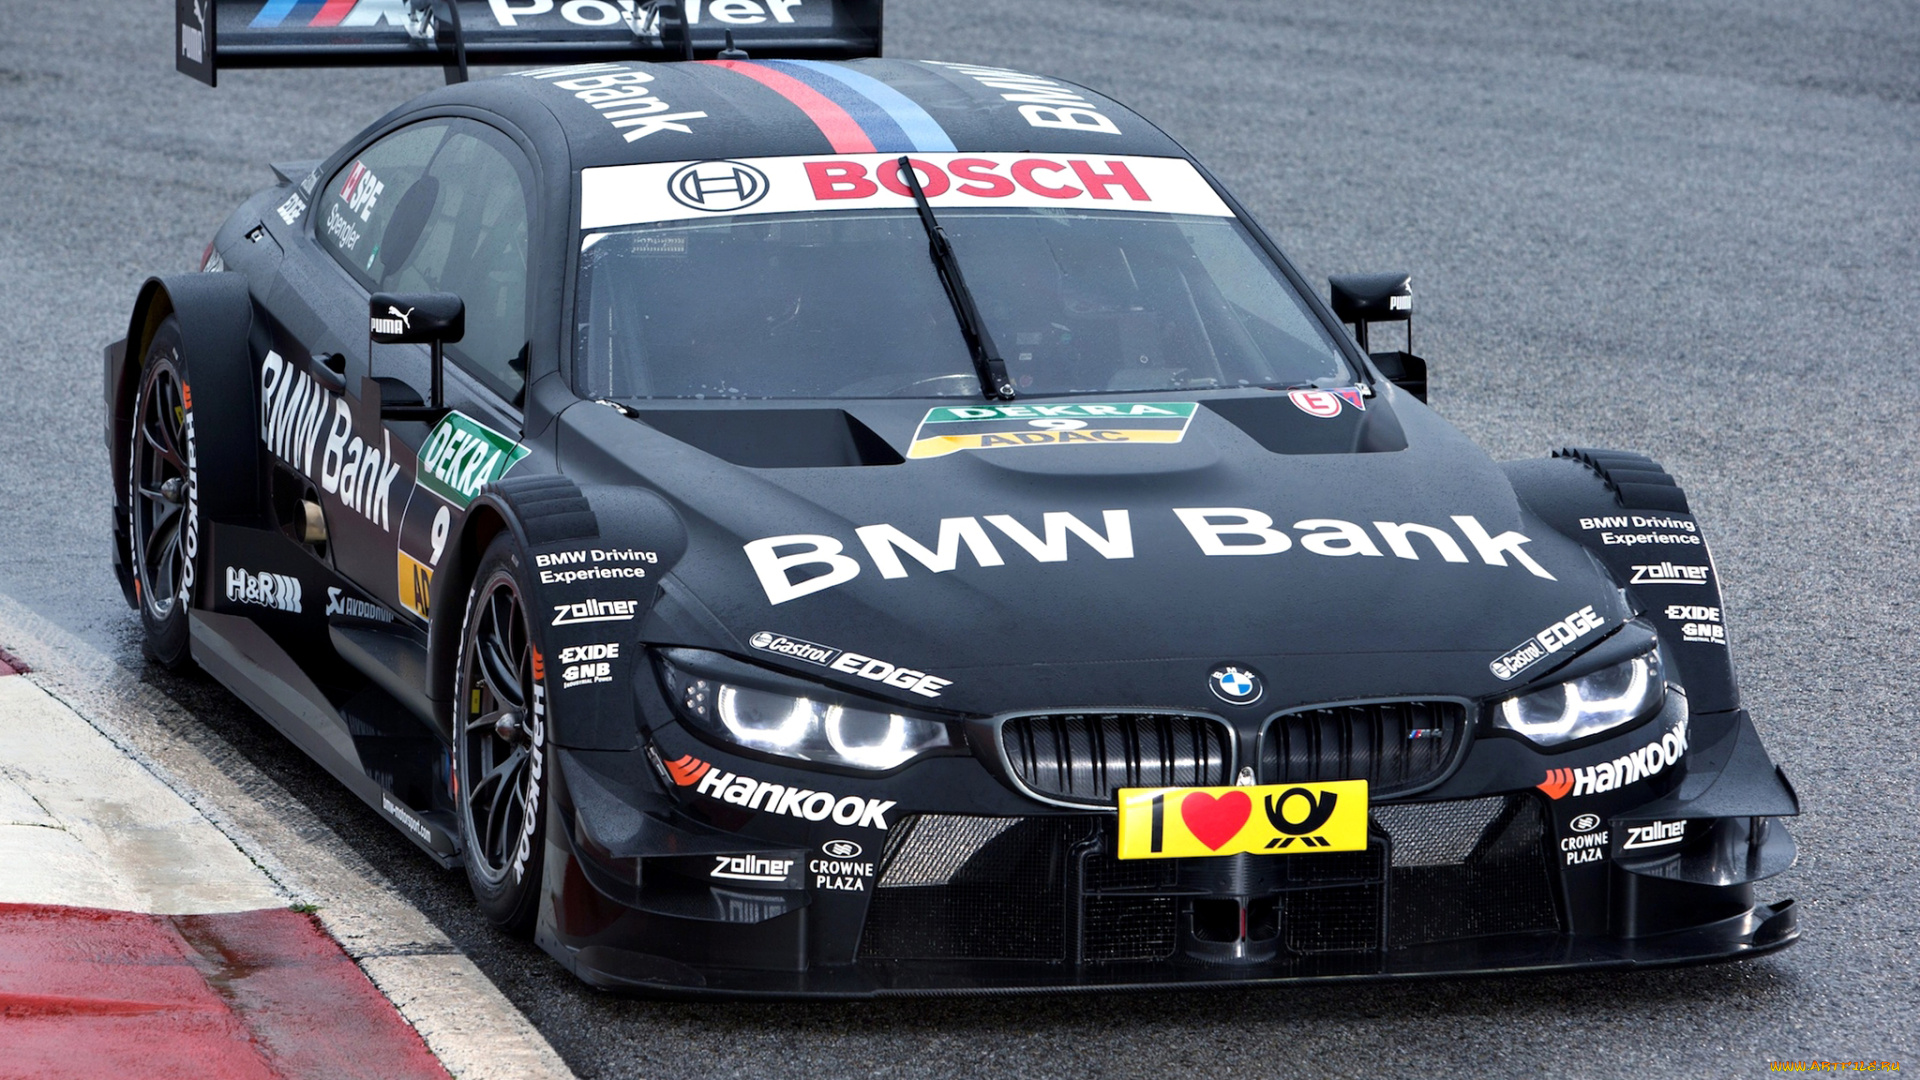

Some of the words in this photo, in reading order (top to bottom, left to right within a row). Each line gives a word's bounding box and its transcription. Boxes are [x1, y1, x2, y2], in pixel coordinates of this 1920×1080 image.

[552, 71, 709, 144] Bank
[803, 158, 1152, 202] BOSCH
[349, 170, 385, 223] SPE
[326, 203, 361, 250] Spengler
[371, 318, 403, 334] PUMA
[1302, 393, 1330, 410] E
[948, 404, 1179, 420] DEKRA
[1028, 419, 1089, 431] 9
[261, 350, 330, 480] BMW
[321, 397, 401, 533] Bank
[980, 430, 1130, 447] ADAC
[423, 421, 502, 497] DEKRA
[1579, 516, 1629, 531] BMW
[1631, 515, 1697, 533] Driving
[429, 506, 451, 566] 9
[1600, 532, 1701, 547] Experience
[535, 550, 587, 568] BMW
[591, 548, 659, 564] Driving
[743, 508, 1135, 606] BMW
[1172, 507, 1559, 583] Bank
[539, 565, 646, 585] Experience
[413, 564, 434, 614] AD
[1664, 604, 1720, 622] EXIDE
[1536, 604, 1606, 653] EDGE
[1681, 622, 1725, 639] GNB
[558, 642, 620, 665] EXIDE
[1503, 640, 1545, 674] Castrol
[562, 662, 611, 682] GNB
[768, 637, 834, 664] Castrol
[829, 652, 954, 698] EDGE
[1151, 794, 1165, 853] I
[1560, 831, 1609, 852] CROWNE
[1566, 848, 1603, 865] PLAZA
[809, 858, 874, 877] CROWNE
[816, 875, 864, 891] PLAZA
